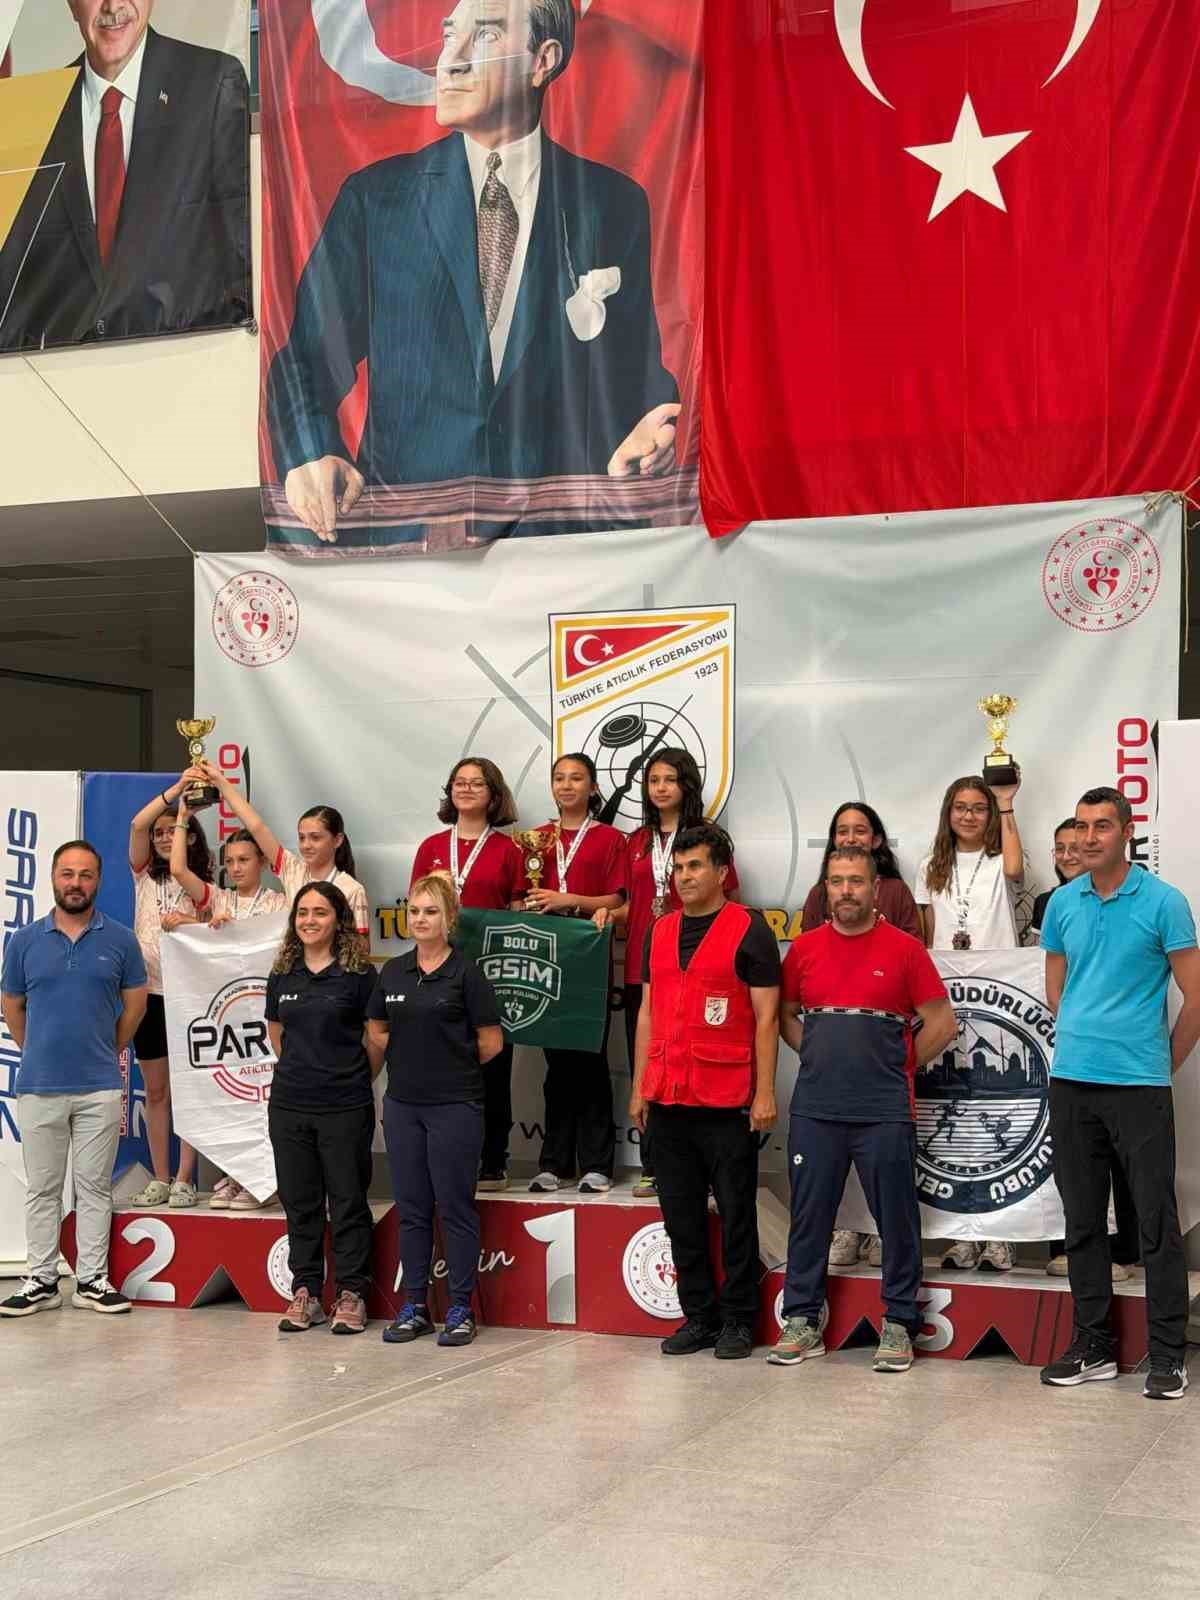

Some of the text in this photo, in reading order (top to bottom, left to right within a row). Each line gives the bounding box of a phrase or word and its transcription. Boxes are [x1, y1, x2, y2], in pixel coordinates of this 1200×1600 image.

[559, 628, 728, 710] TÜRKİYE ATICILIK FEDERASYONU
[693, 662, 719, 680] 1923
[503, 935, 539, 951] BOLU
[989, 1135, 1053, 1204] ULÜBÜ
[120, 1216, 176, 1303] 2
[522, 1208, 577, 1325] 1
[914, 1287, 954, 1352] 3
